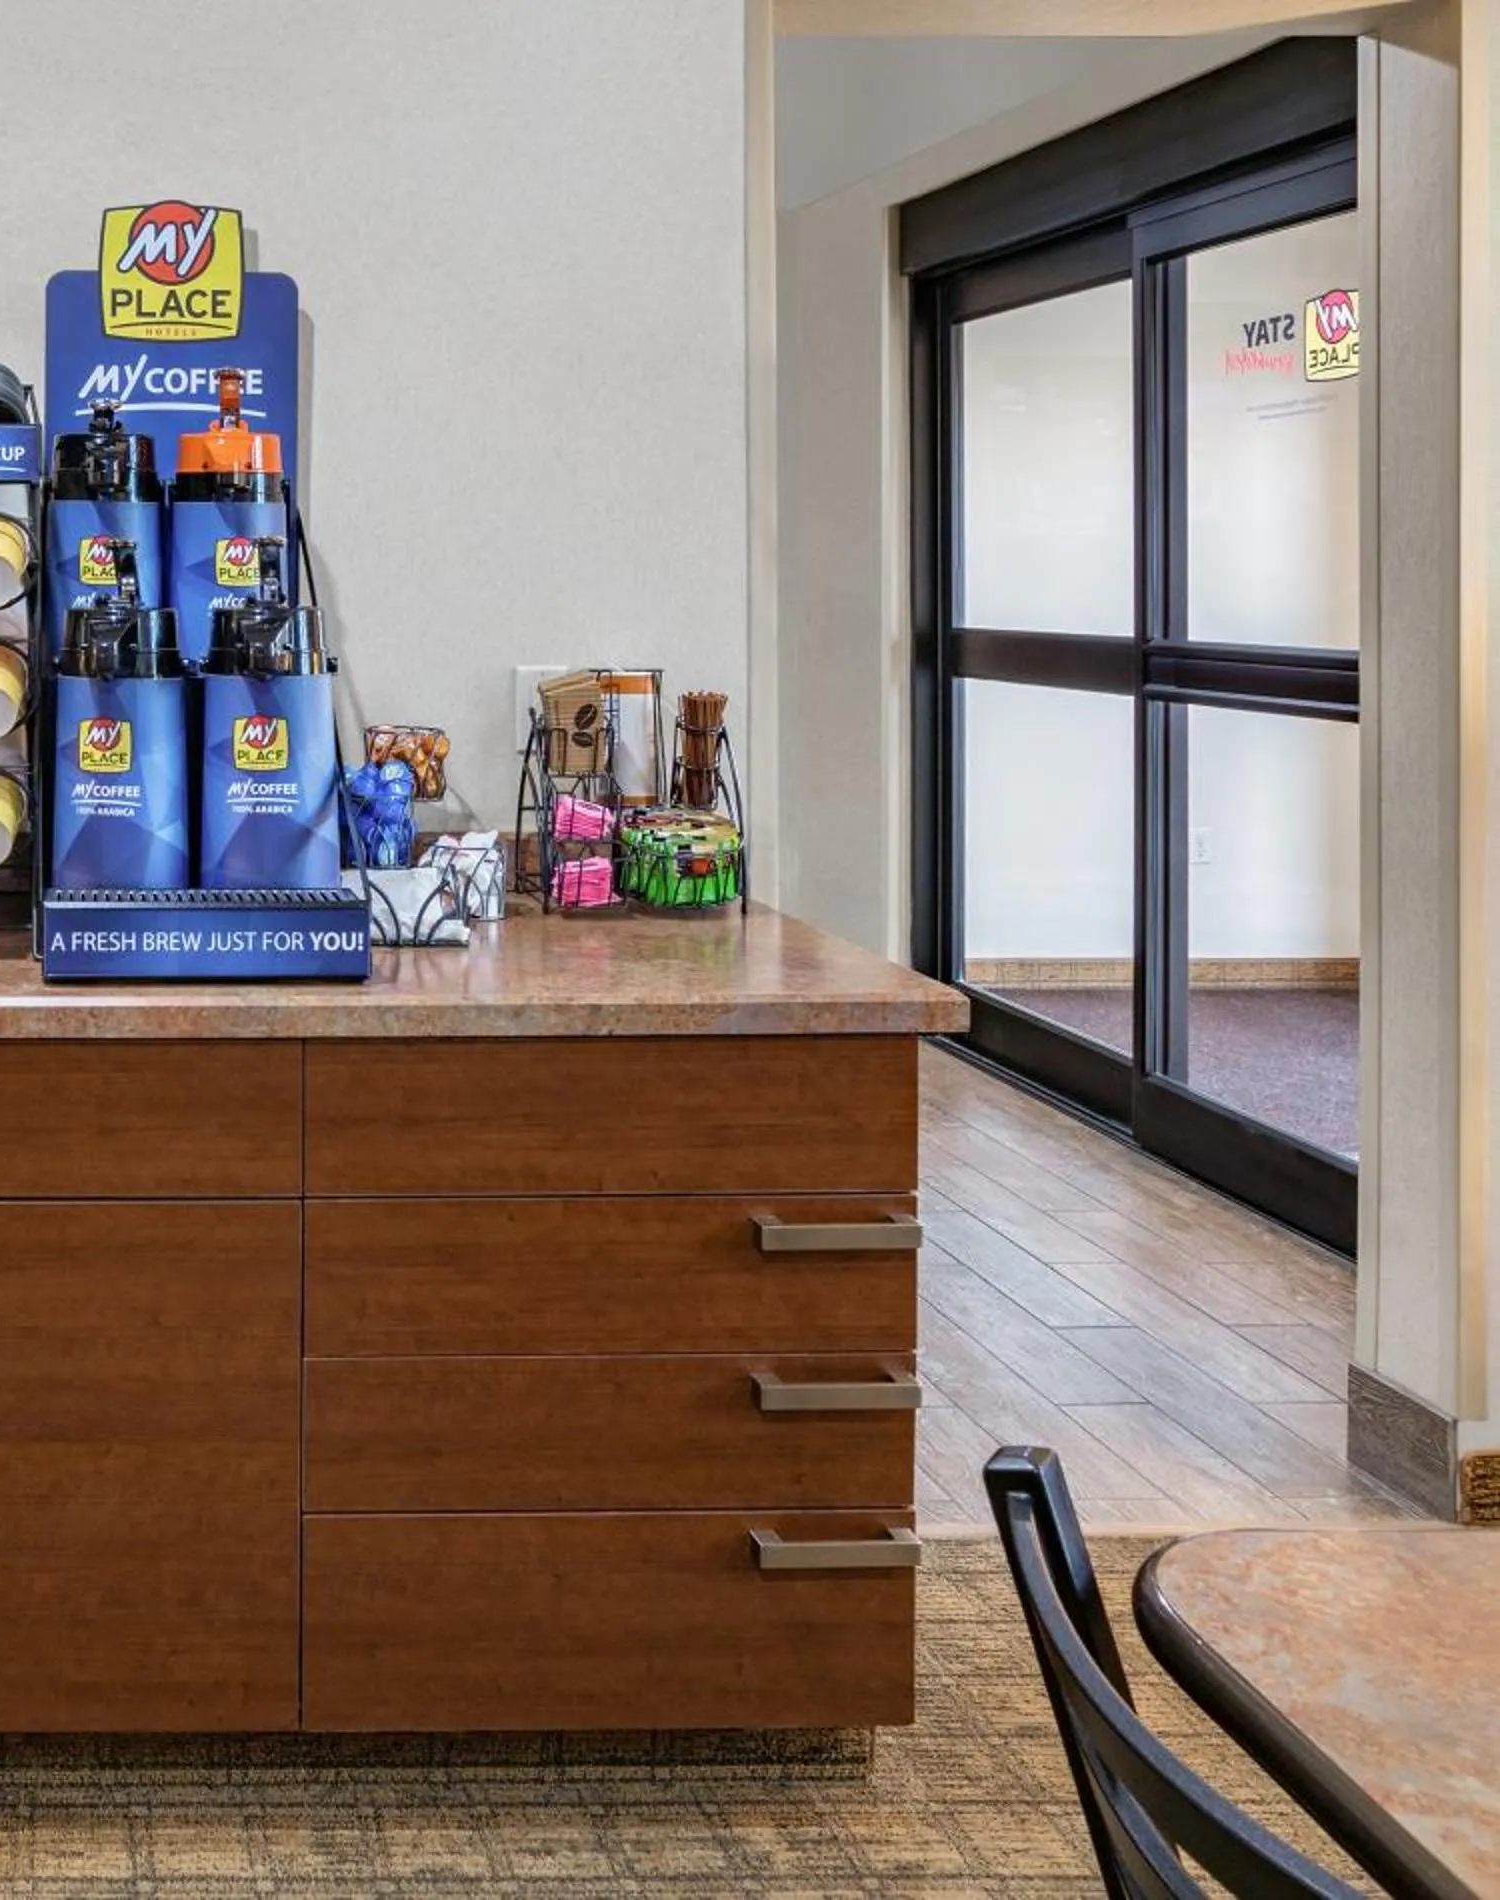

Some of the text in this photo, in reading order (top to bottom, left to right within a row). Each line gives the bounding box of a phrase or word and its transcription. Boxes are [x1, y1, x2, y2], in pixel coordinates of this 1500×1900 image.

[110, 289, 232, 318] PLACE
[82, 564, 116, 577] PLAC
[219, 566, 260, 579] PLACE
[81, 752, 129, 765] PLACE
[237, 749, 285, 761] PLACE
[51, 931, 364, 951] A FRESH BREW JUST FOR YOU!
